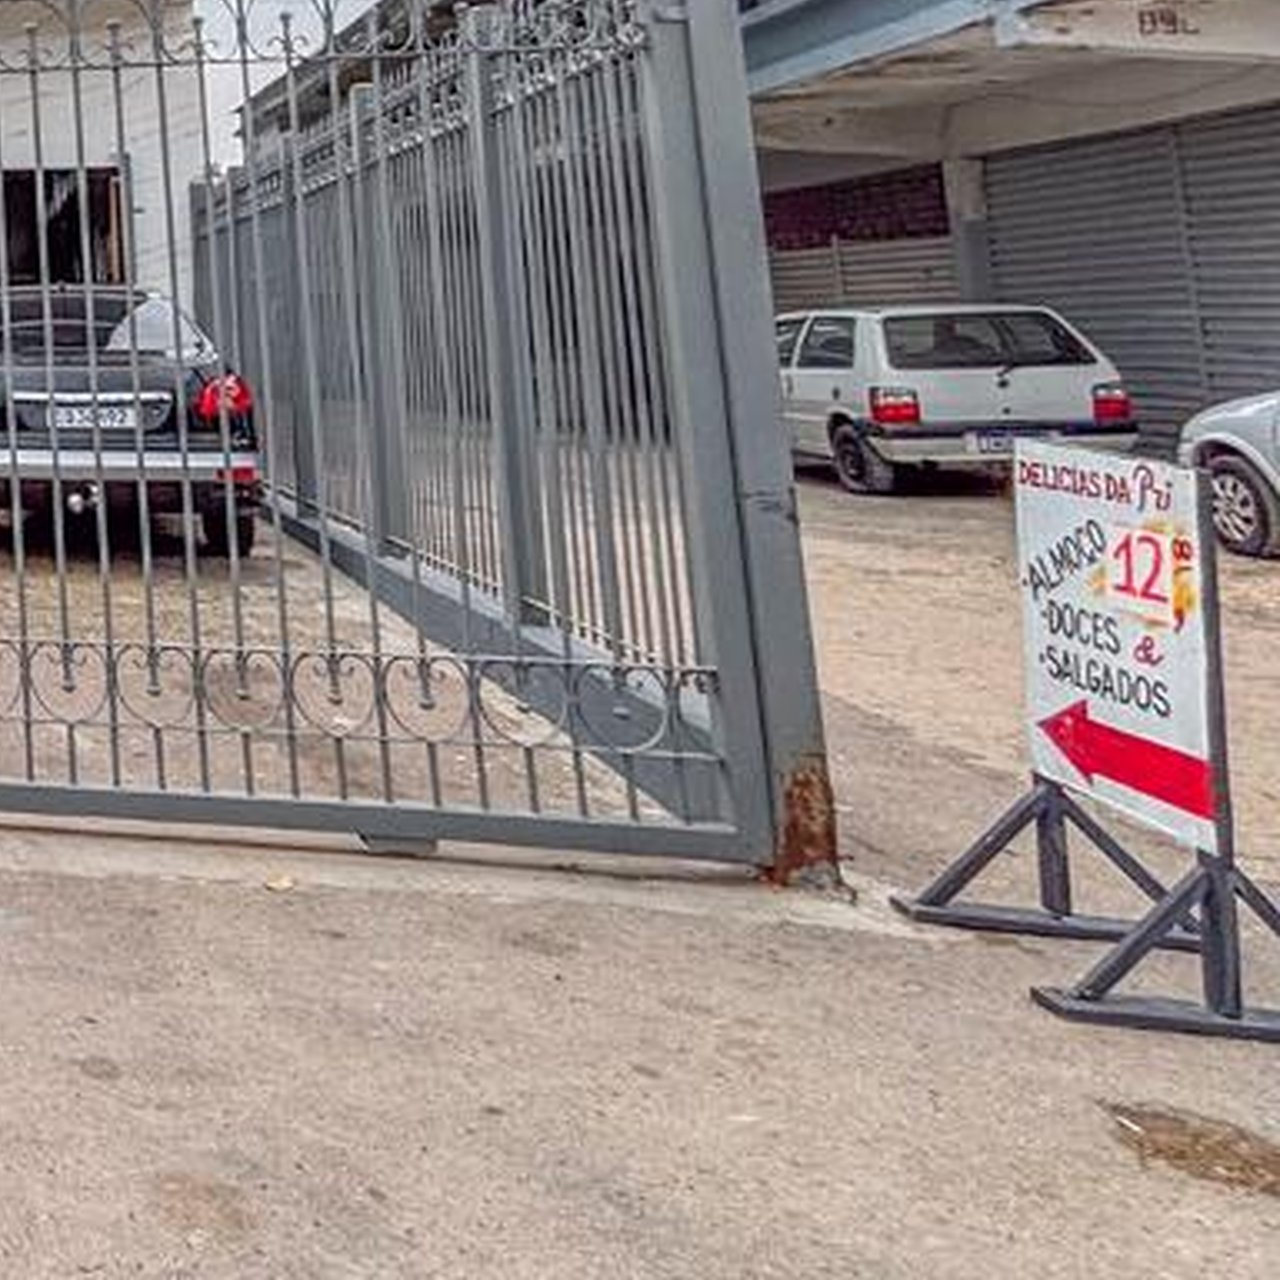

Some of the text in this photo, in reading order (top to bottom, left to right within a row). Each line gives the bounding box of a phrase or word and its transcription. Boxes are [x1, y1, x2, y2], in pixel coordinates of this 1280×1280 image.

[1105, 472, 1132, 504] DA
[1047, 598, 1122, 656] DOCES
[1045, 644, 1172, 719] SALGADOS
